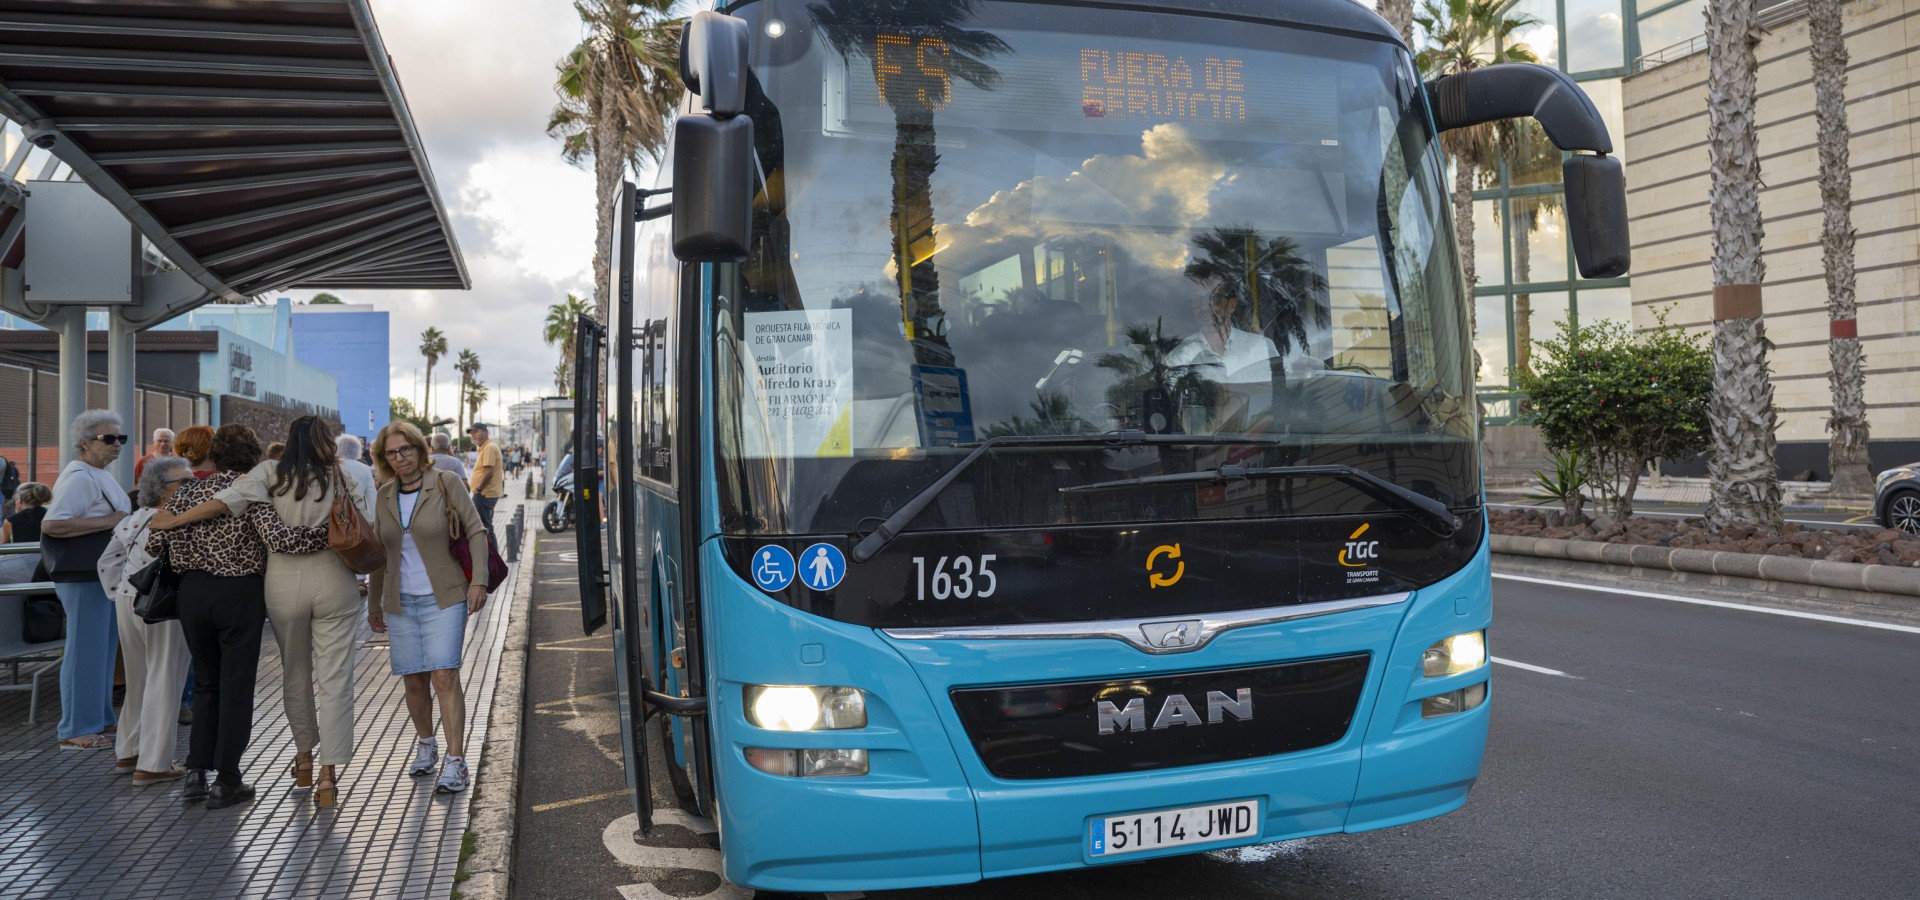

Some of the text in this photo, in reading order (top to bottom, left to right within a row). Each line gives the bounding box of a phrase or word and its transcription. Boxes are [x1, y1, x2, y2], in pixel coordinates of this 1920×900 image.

[1081, 49, 1245, 91] FUERA DE
[755, 320, 841, 334] ORQUESTA FILARMÓNICA
[755, 333, 818, 345] DE GRAN CANARIA
[757, 363, 813, 376] Auditorio
[757, 377, 837, 390] Alfredo Kraus
[766, 405, 832, 420] en guagua
[1345, 540, 1379, 559] TGC
[912, 554, 998, 600] 1635
[1097, 687, 1253, 735] MAN
[1111, 805, 1251, 849] 5114 JWD
[1095, 840, 1101, 849] E
